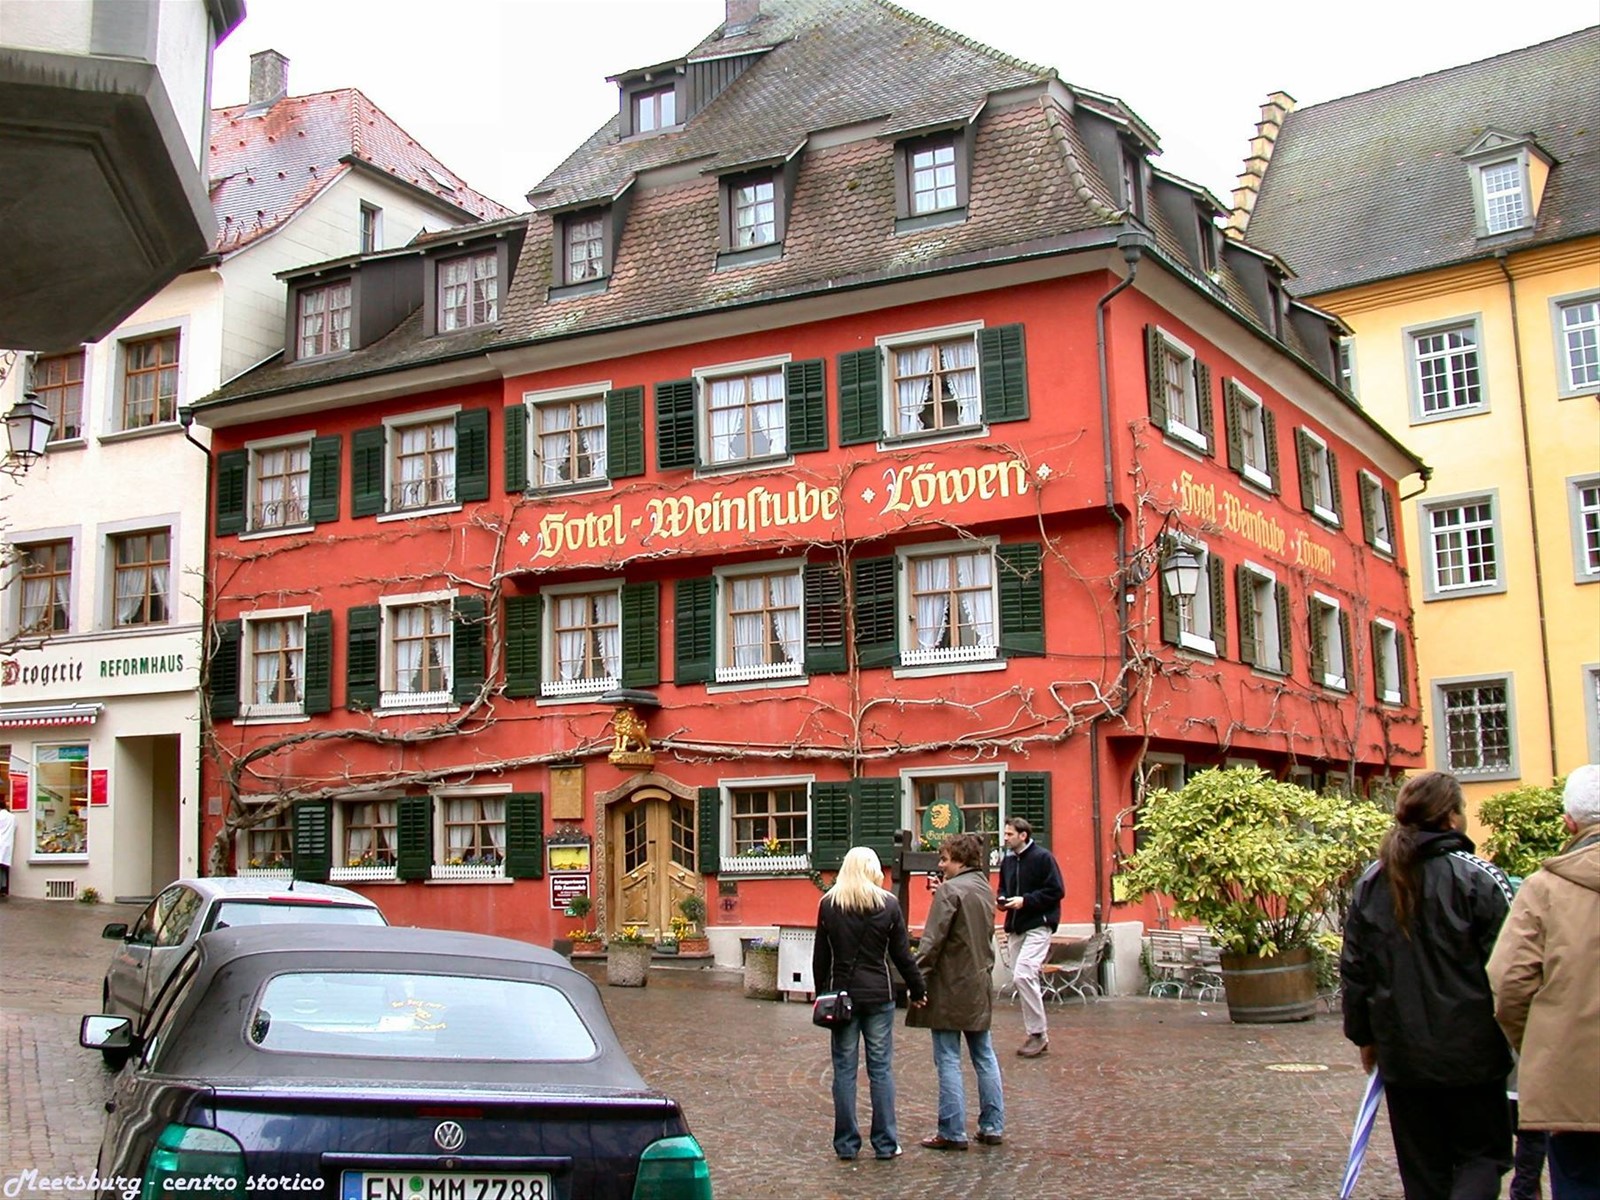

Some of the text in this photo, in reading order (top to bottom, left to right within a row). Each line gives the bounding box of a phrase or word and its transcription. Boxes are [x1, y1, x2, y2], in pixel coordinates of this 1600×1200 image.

[530, 504, 627, 562] Hotel
[879, 460, 1029, 515] Löwen
[1180, 470, 1217, 524] Hotel
[1, 654, 184, 687] Drogerie REFORMHAUS
[429, 1178, 465, 1200] MM
